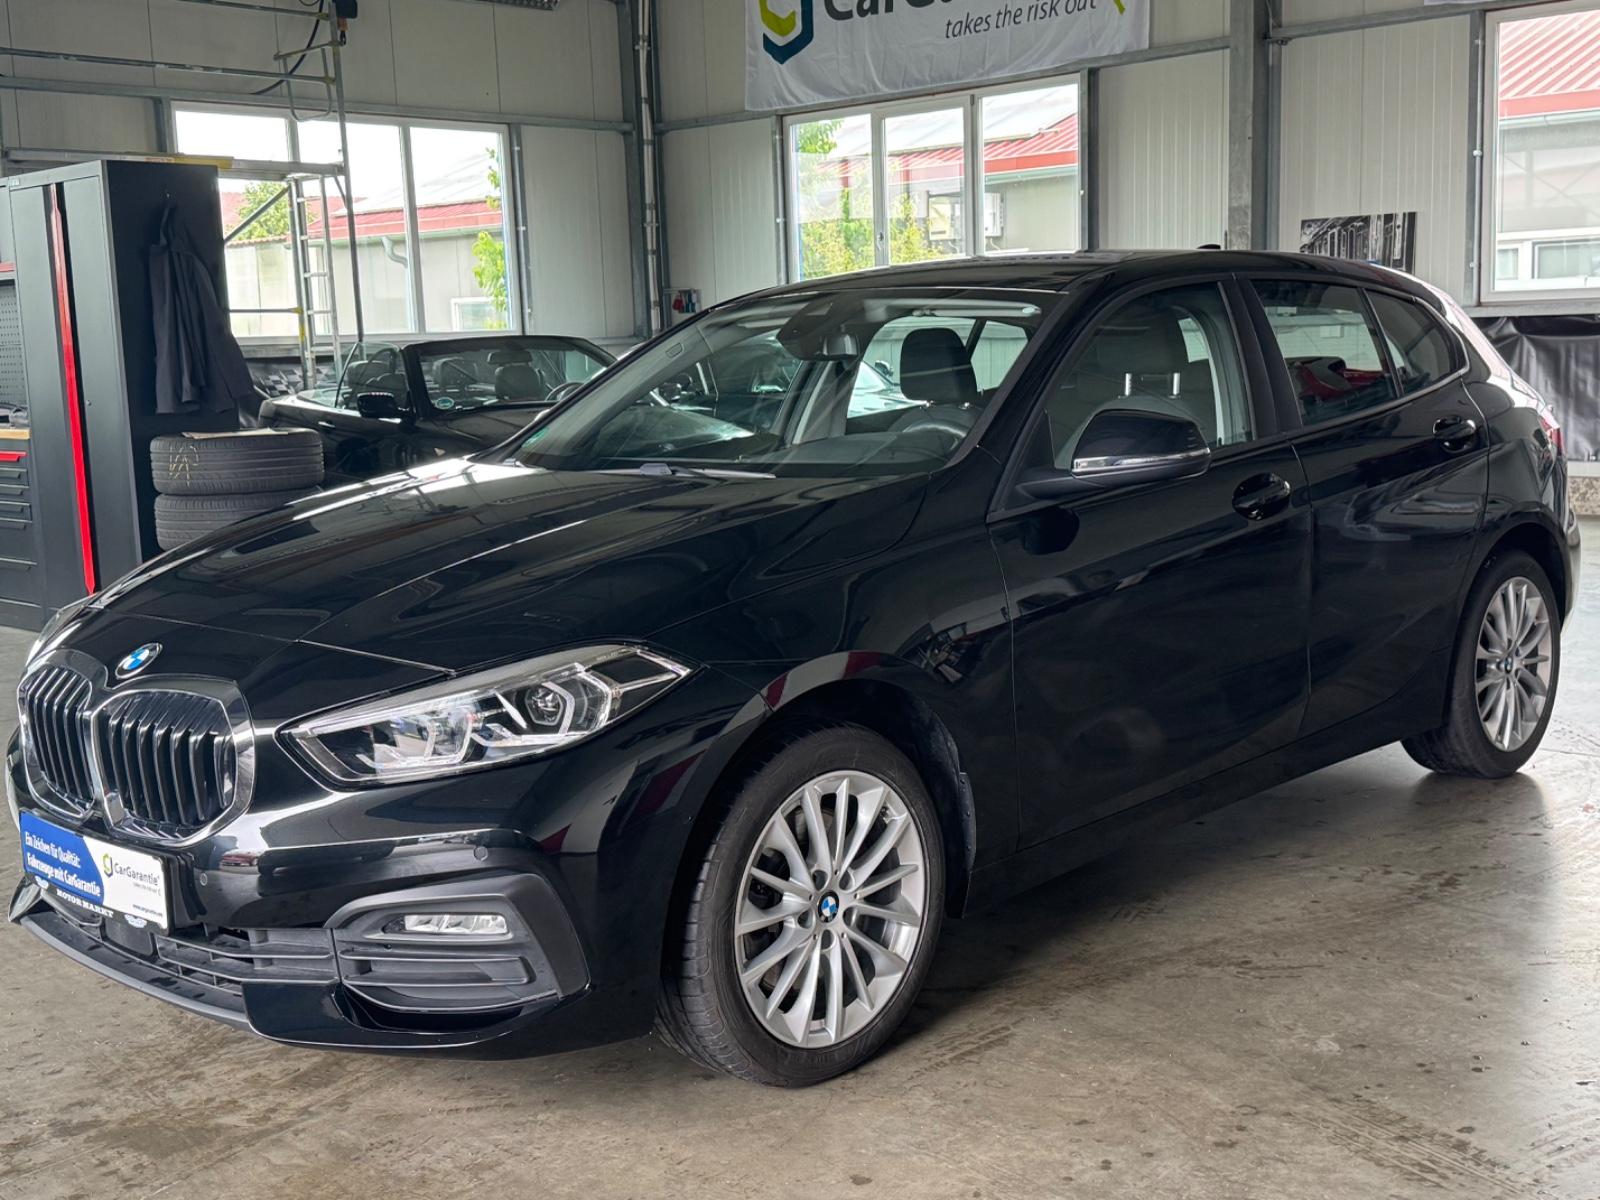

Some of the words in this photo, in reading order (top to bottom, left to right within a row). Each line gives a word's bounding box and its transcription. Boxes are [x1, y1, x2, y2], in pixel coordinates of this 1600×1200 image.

[945, 12, 991, 38] takes
[995, 4, 1023, 29] the
[1026, 0, 1059, 22] risk
[25, 831, 33, 847] Ein
[33, 836, 51, 856] Zeichen
